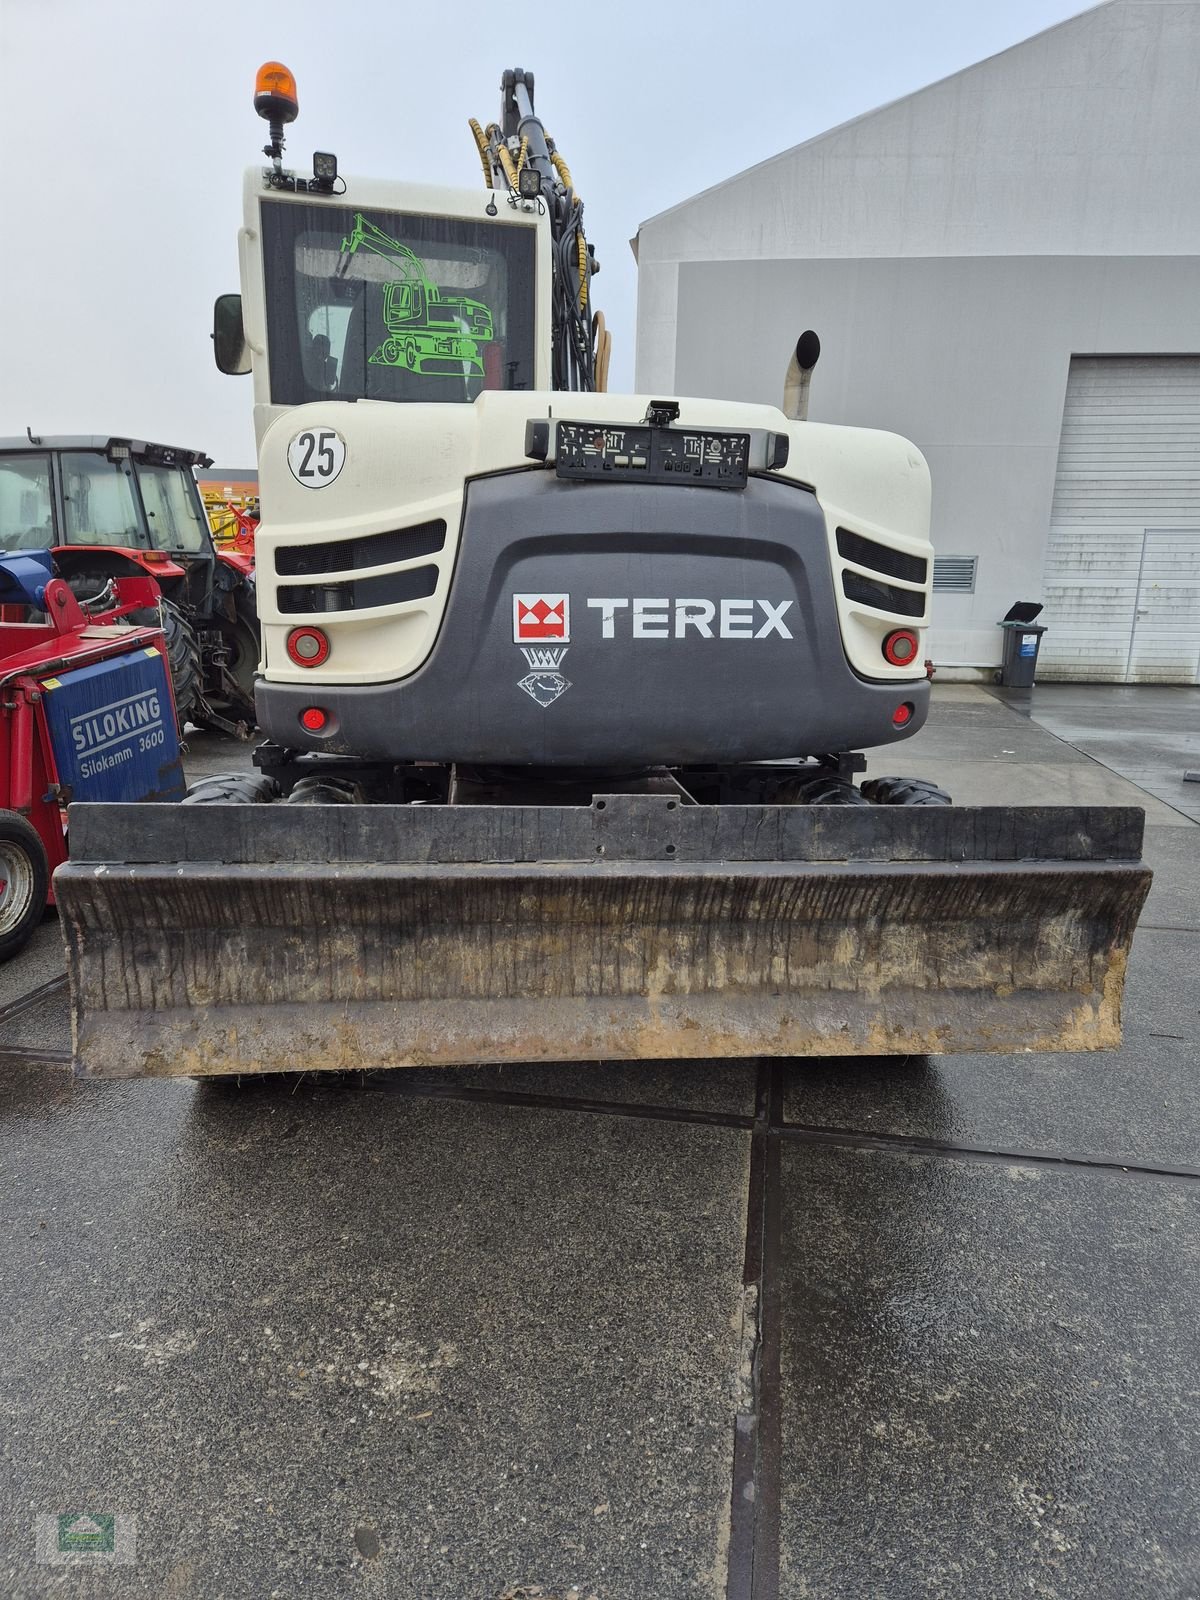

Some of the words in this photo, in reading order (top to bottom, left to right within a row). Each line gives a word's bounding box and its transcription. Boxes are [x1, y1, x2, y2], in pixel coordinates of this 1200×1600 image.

[299, 432, 336, 477] 25
[586, 597, 794, 640] TEREX
[72, 696, 161, 751] SILOKING
[80, 747, 133, 779] Silokamm
[139, 729, 165, 752] 3600
